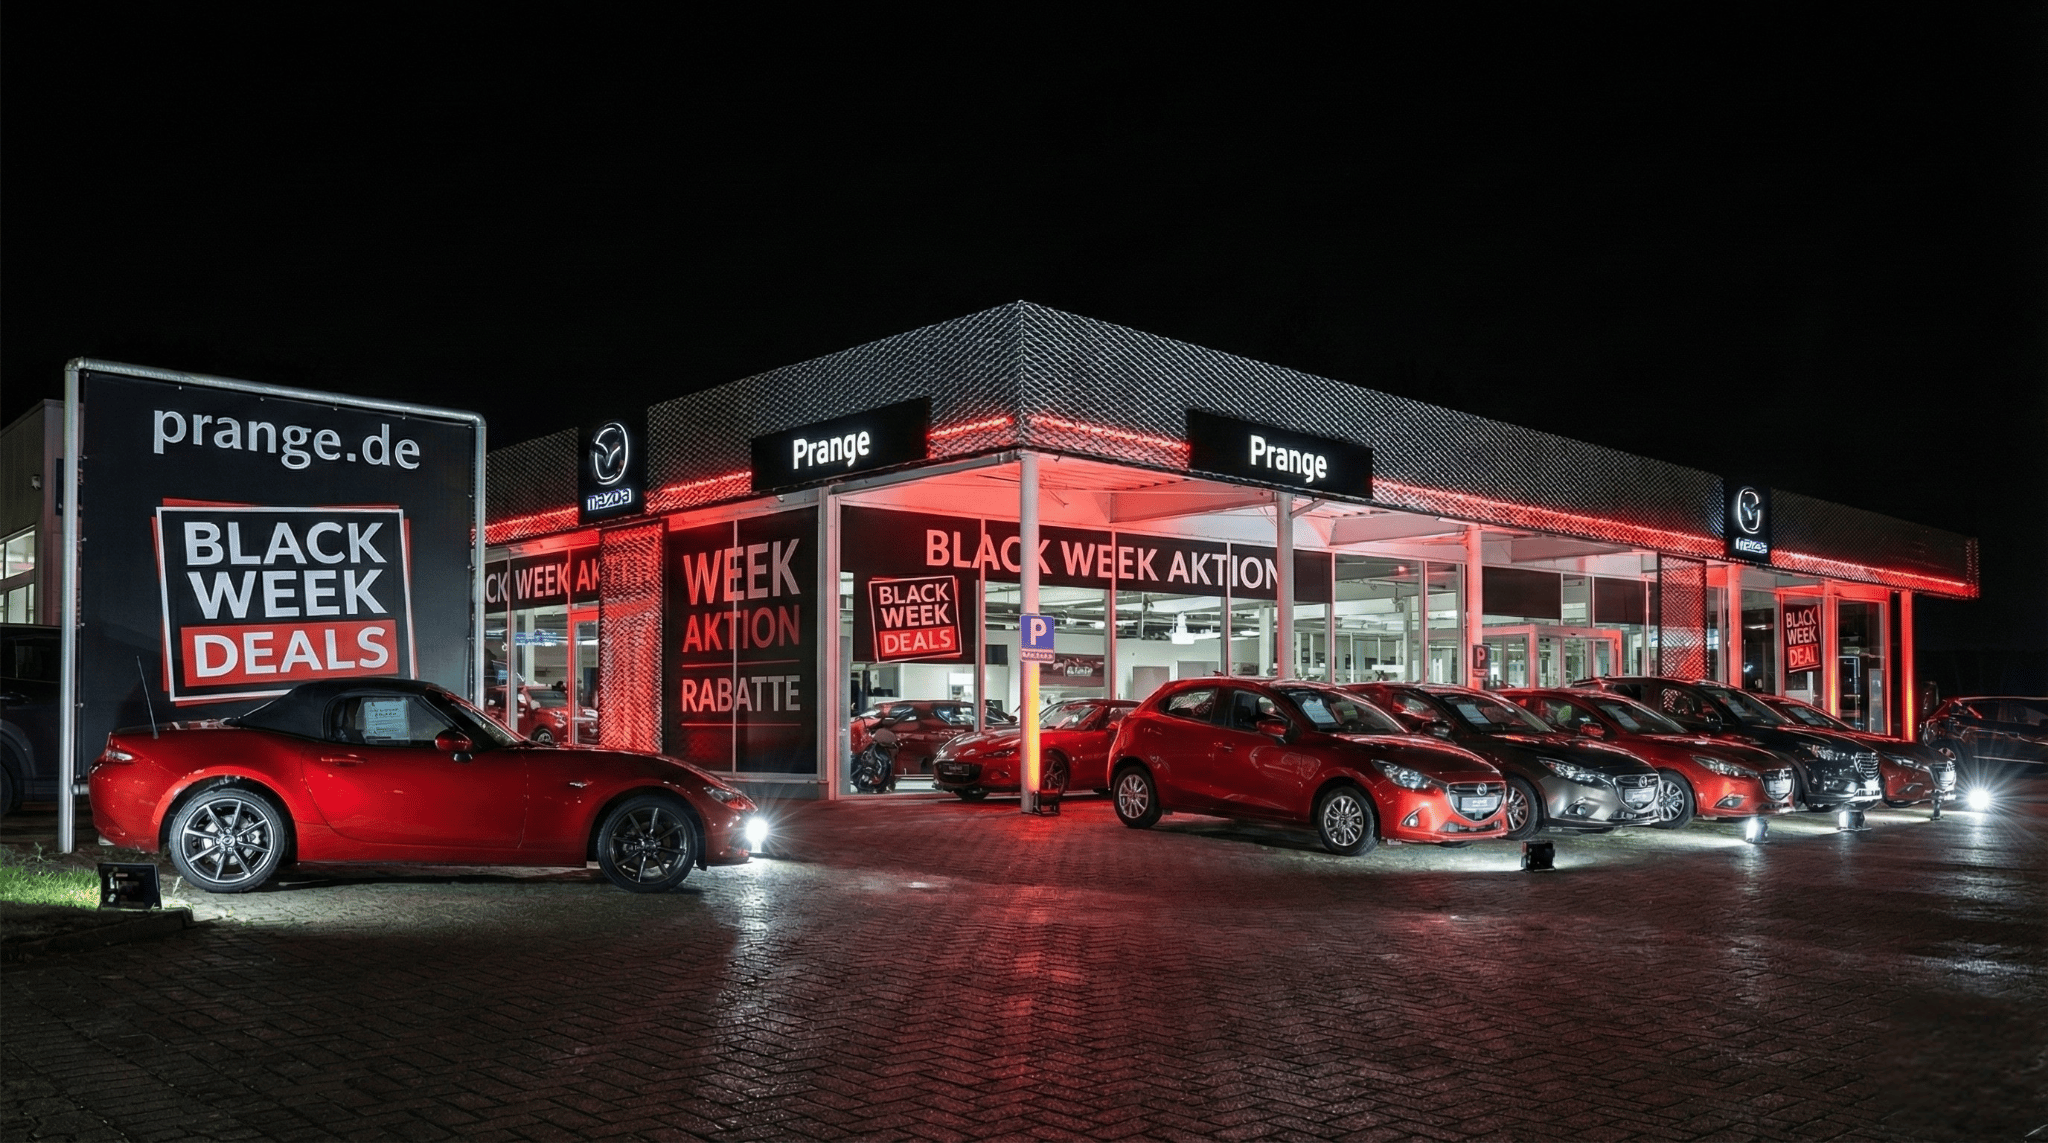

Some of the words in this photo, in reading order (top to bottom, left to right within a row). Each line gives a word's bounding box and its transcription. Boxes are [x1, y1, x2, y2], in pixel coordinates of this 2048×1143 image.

[153, 410, 420, 469] prange.de
[793, 430, 871, 470] Prange
[1250, 434, 1328, 484] Prange
[184, 521, 388, 566] BLACK
[515, 562, 570, 600] WEEK
[683, 538, 801, 605] WEEK
[1060, 540, 1159, 582] WEEK
[1167, 550, 1278, 590] AKTION
[187, 569, 388, 619] WEEK
[879, 582, 951, 605] BLACK
[682, 604, 800, 653] AKTION
[880, 603, 951, 629] WEEK
[1030, 618, 1047, 645] P
[1785, 606, 1817, 628] BLACK
[1787, 625, 1817, 646] WEEK
[194, 626, 389, 678] DEALS
[883, 629, 952, 654] DEALS
[682, 674, 801, 713] RABATTE
